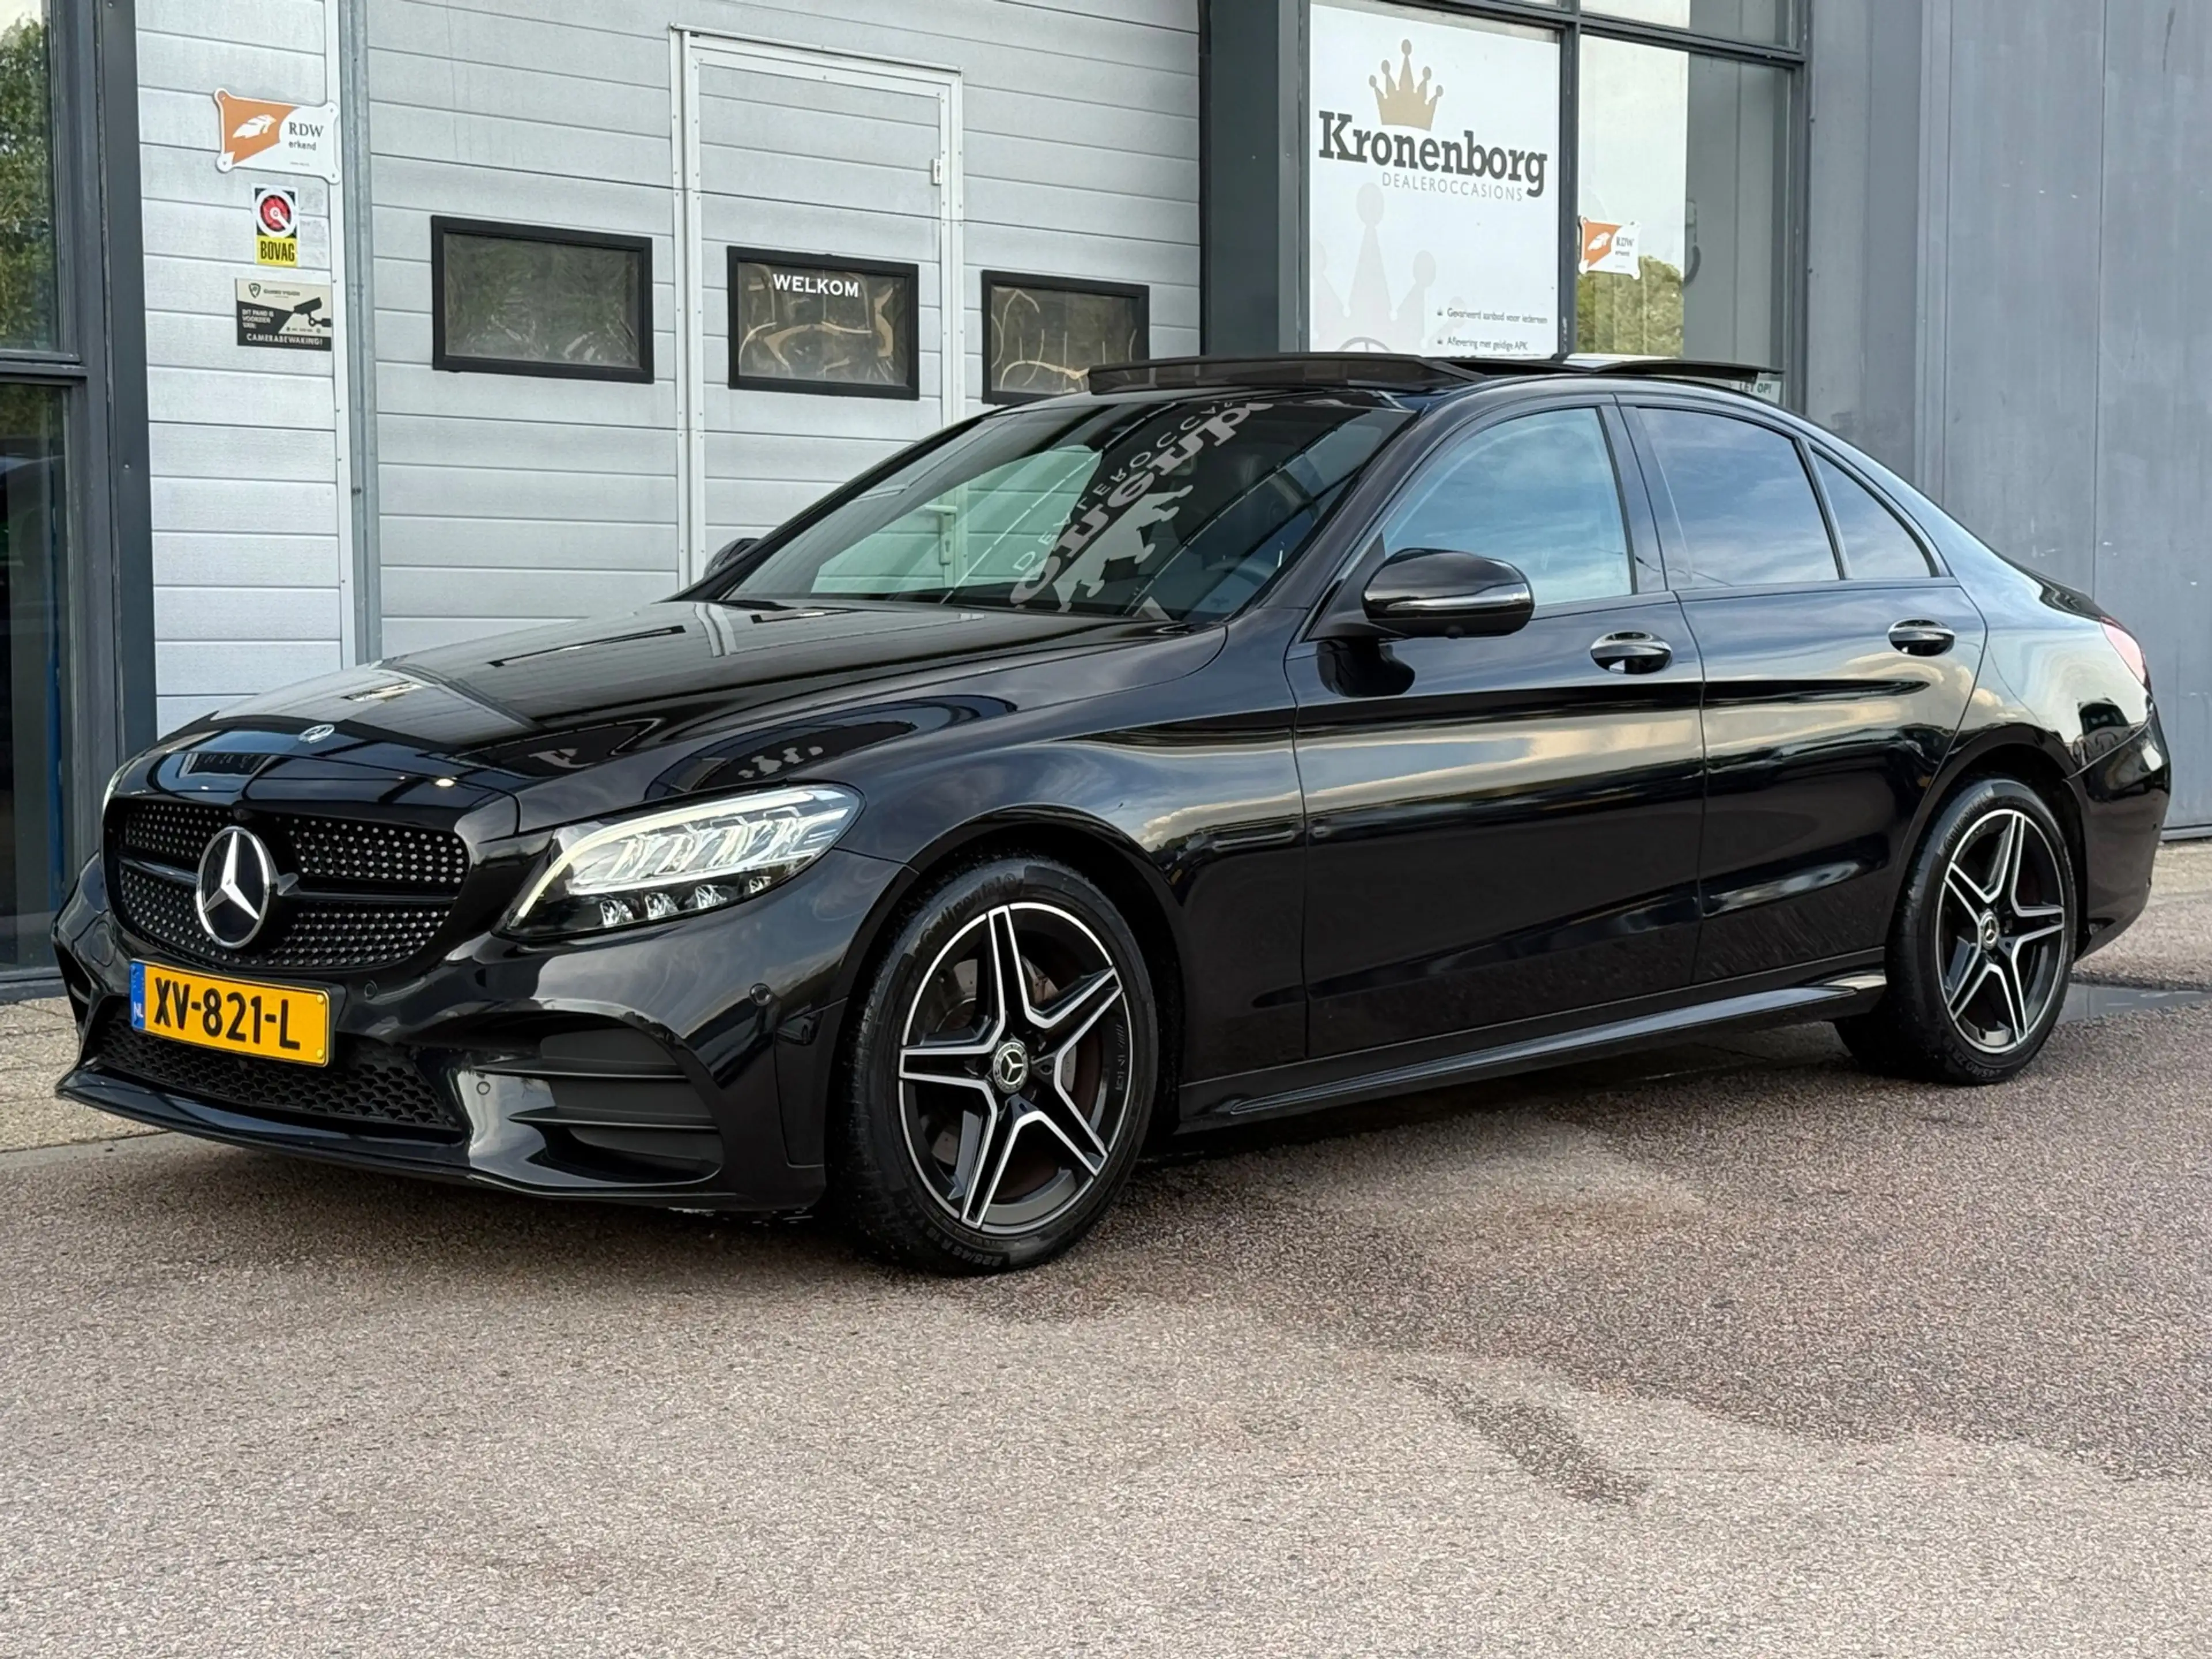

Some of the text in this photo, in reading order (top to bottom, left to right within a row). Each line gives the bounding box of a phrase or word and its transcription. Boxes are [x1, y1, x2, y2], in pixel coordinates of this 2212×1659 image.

[289, 122, 324, 138] RDW
[289, 139, 317, 151] erkend
[1319, 110, 1548, 198] Kronenborg
[1382, 171, 1522, 202] DEALEROCCASIONS
[260, 240, 295, 262] BOVAG
[772, 274, 859, 297] WELKOM
[153, 977, 301, 1050] XV-821-L
